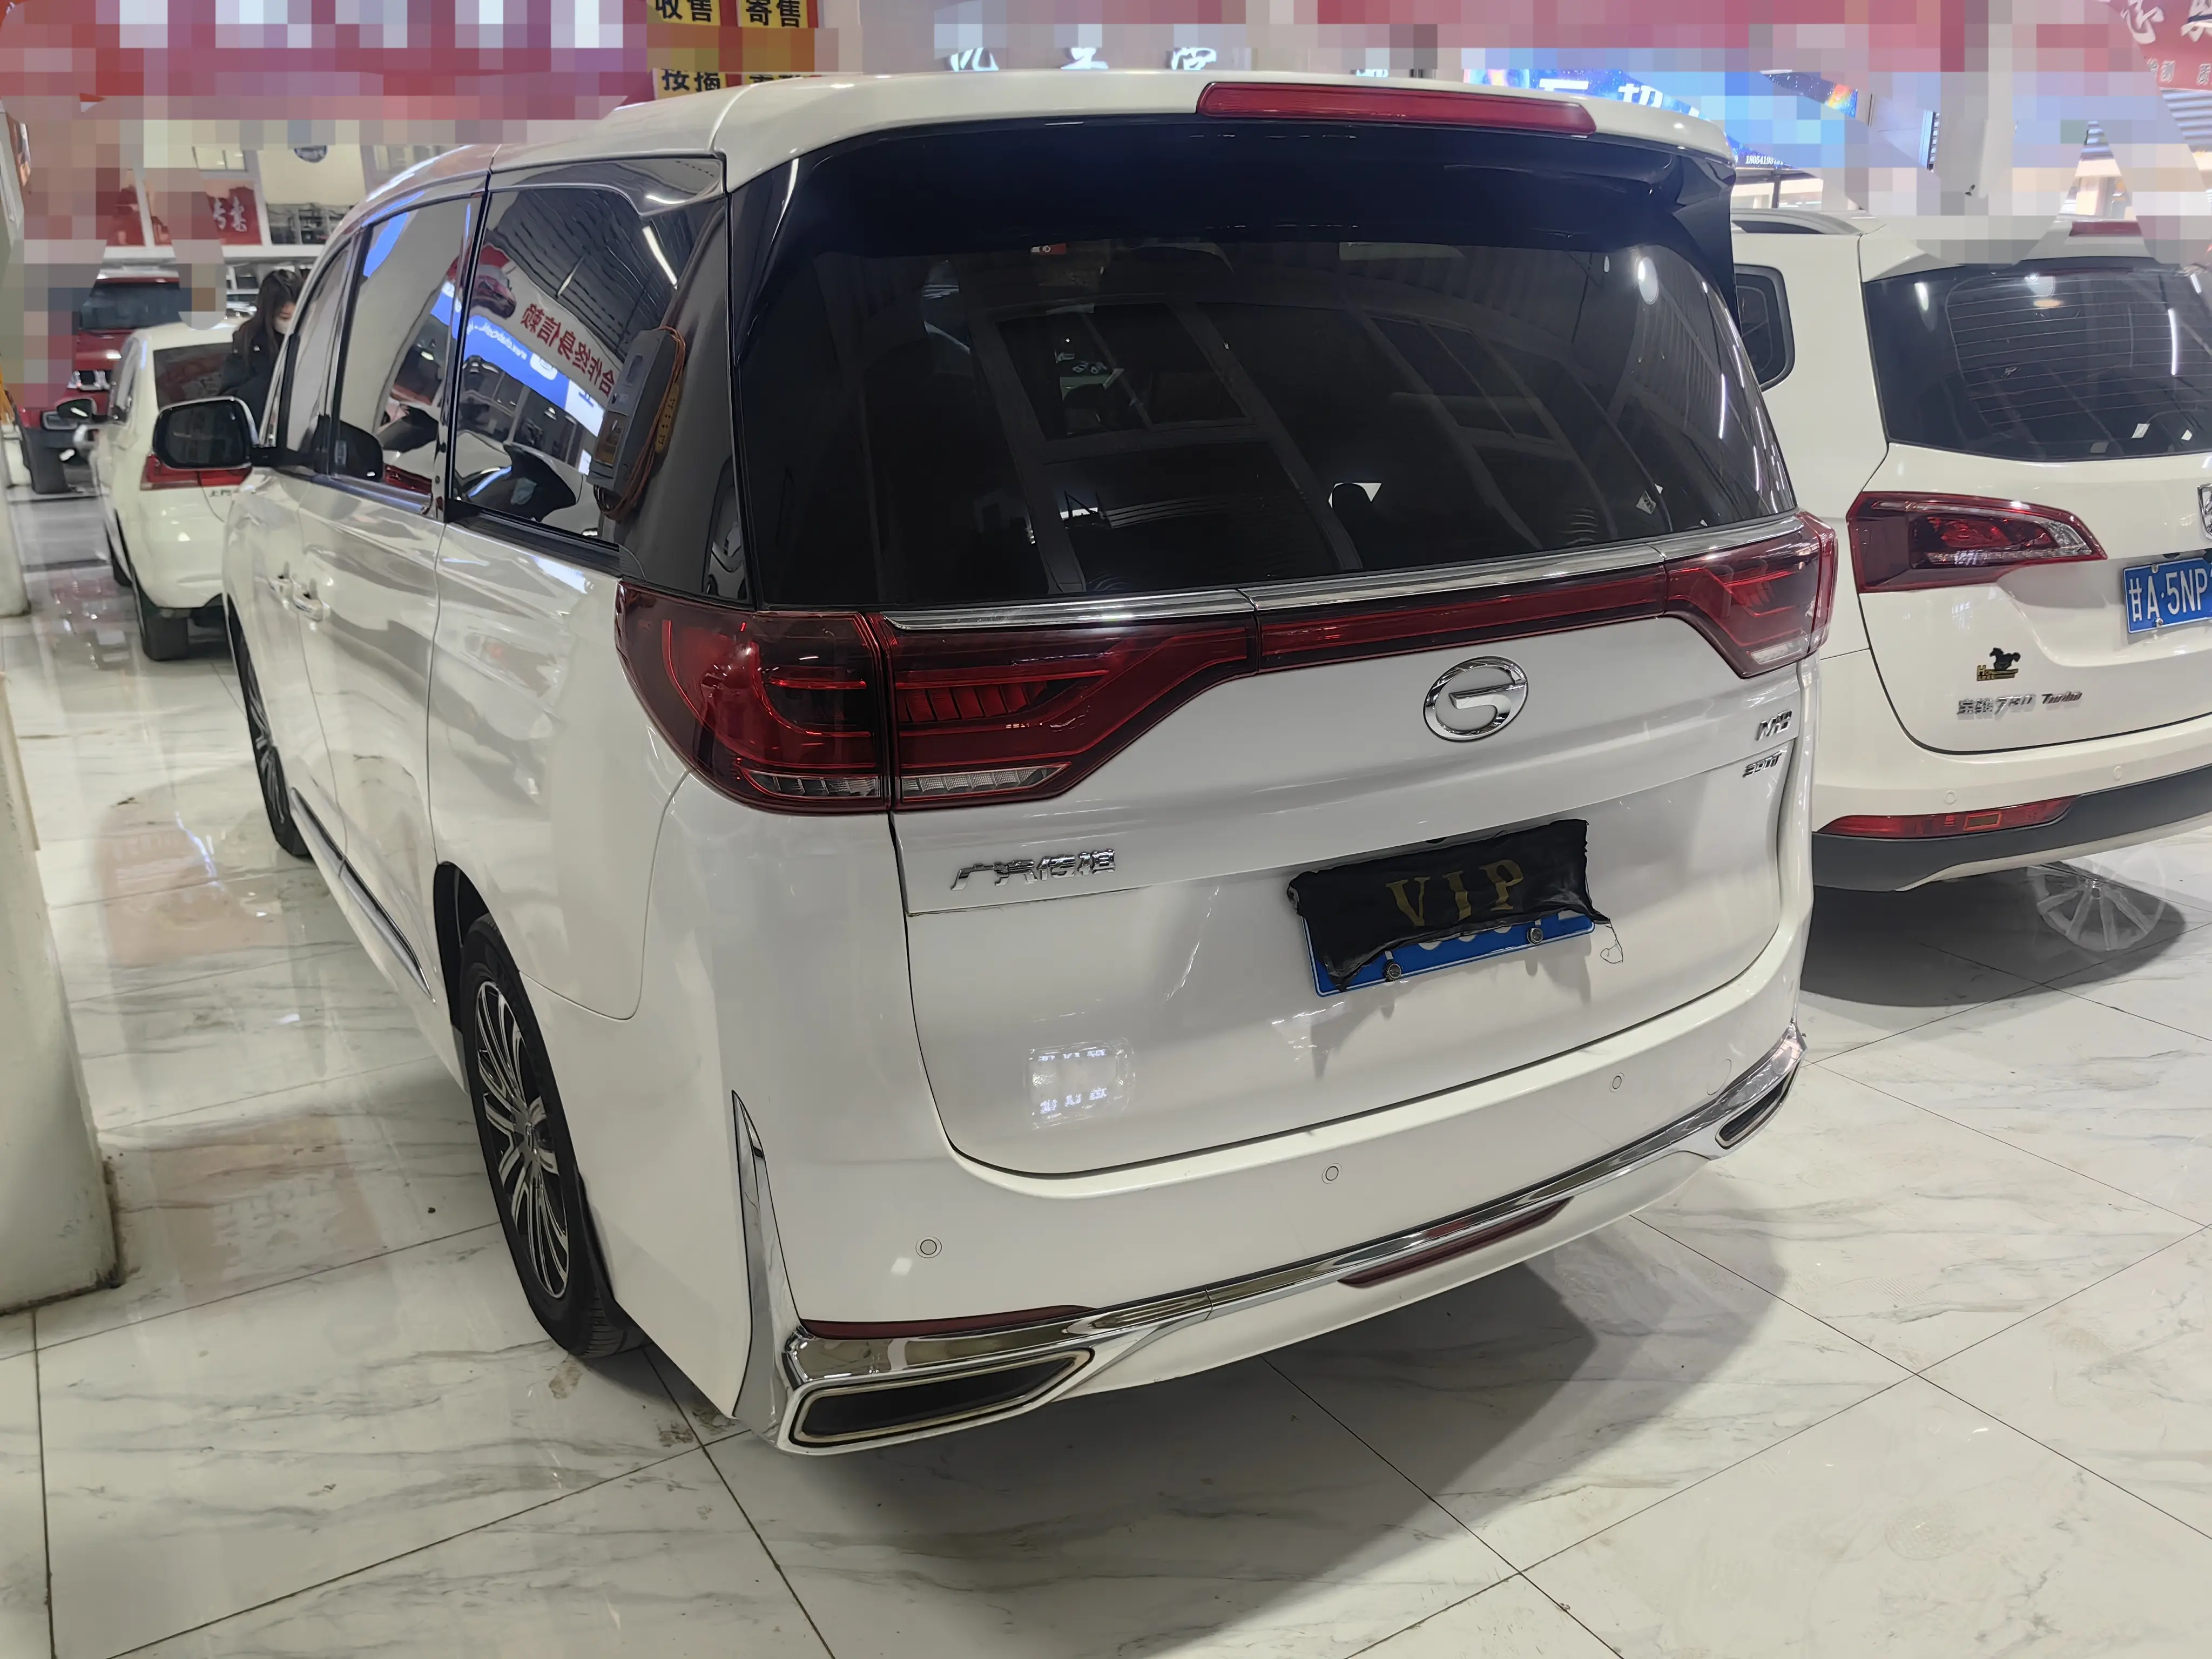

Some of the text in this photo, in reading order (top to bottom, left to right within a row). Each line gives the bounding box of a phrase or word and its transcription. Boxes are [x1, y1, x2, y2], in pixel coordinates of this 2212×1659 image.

[655, 0, 713, 23] 收售
[746, 0, 801, 28] 寄售
[2129, 568, 2212, 622] 甘A·5NP
[2041, 691, 2083, 705] Turbo
[1755, 709, 1793, 741] M8
[1385, 859, 1524, 927] VIP
